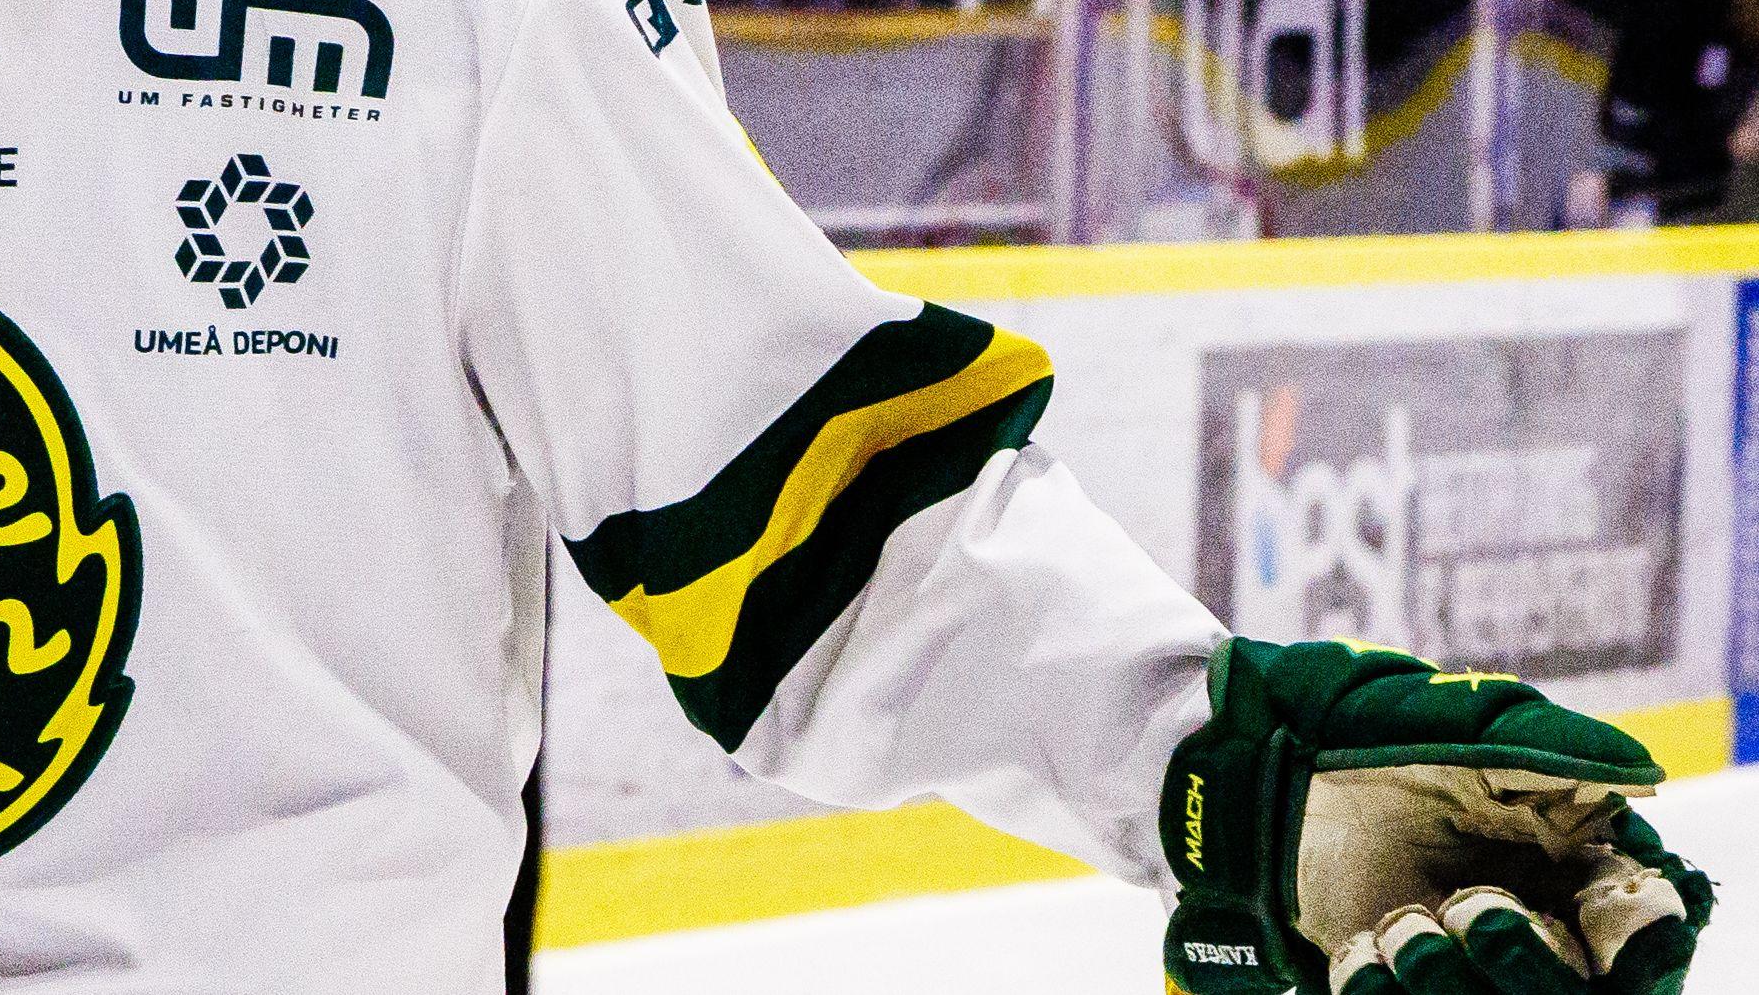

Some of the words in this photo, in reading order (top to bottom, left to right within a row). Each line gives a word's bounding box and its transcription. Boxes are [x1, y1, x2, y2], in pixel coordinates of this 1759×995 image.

[118, 89, 160, 108] UM
[182, 93, 381, 123] FASTIGHETER
[134, 325, 221, 356] UMEÅ
[233, 331, 340, 360] DEPONI
